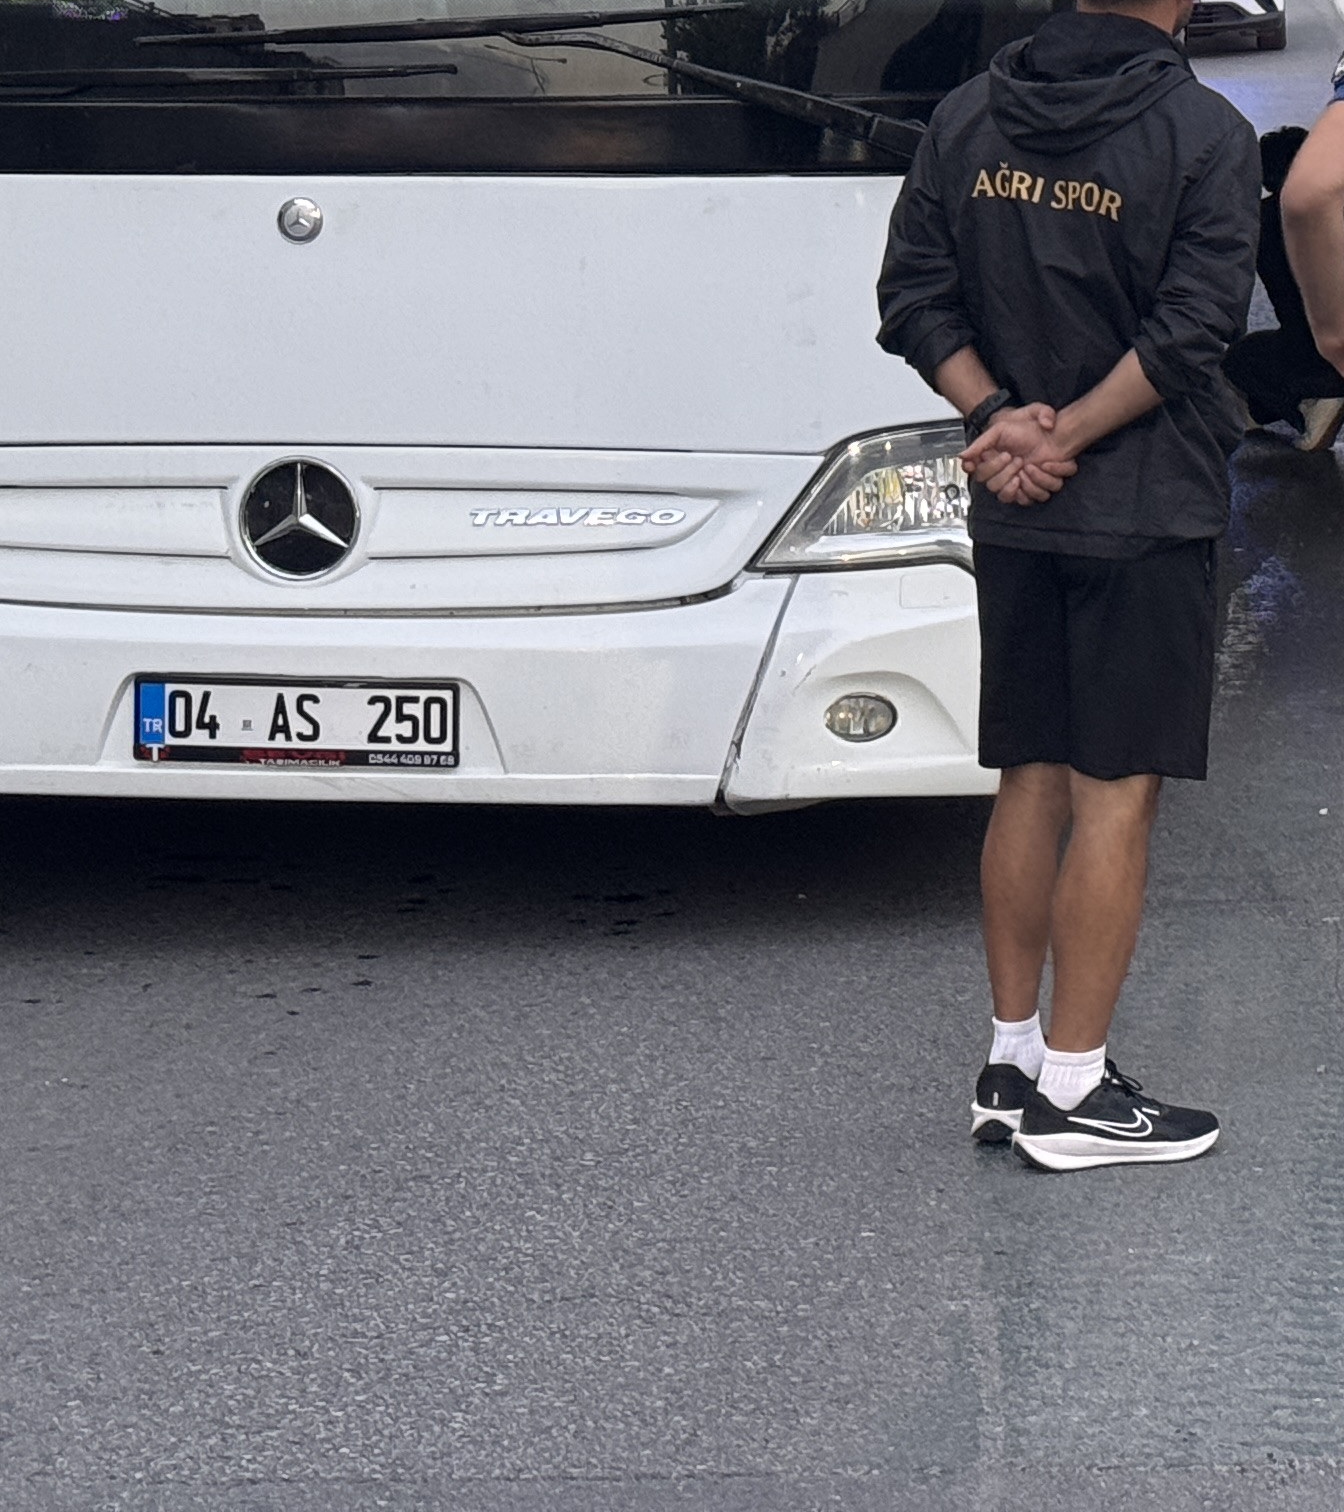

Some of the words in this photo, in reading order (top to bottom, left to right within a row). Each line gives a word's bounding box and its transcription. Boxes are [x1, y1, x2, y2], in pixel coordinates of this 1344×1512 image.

[971, 161, 1045, 204] AĞRI
[1050, 180, 1123, 222] SPOR
[470, 507, 686, 527] TRAVEGO
[142, 717, 163, 734] TR
[169, 689, 220, 739] 04
[268, 693, 321, 742] AS
[367, 695, 448, 745] 250
